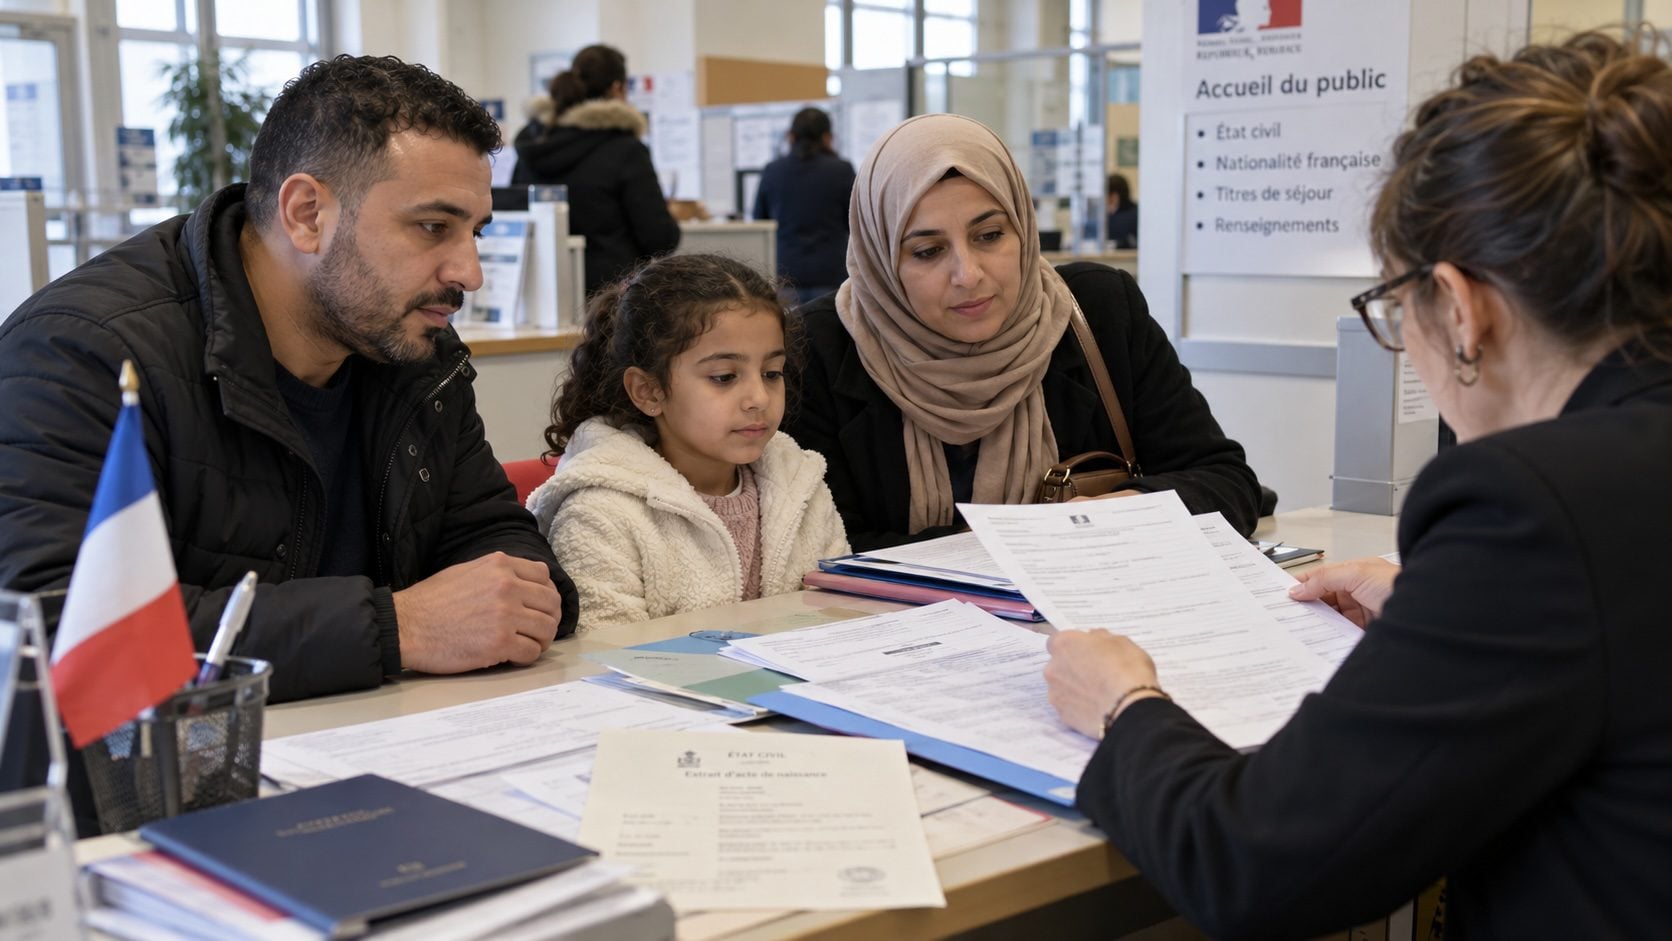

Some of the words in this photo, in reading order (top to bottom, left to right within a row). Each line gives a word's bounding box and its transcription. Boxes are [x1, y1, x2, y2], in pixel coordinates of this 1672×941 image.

[1196, 75, 1272, 99] Accueil
[1280, 73, 1308, 95] du
[1316, 68, 1387, 98] public
[1216, 122, 1247, 141] État
[1251, 122, 1282, 139] civil
[1216, 152, 1302, 171] Nationalité
[1307, 151, 1382, 171] française
[1216, 185, 1258, 202] Titres
[1261, 186, 1281, 201] de
[1286, 185, 1334, 205] séjour
[1215, 216, 1340, 237] Renseignements
[757, 751, 786, 759] CIVIL
[684, 770, 721, 778] Extrait
[761, 770, 774, 778] de
